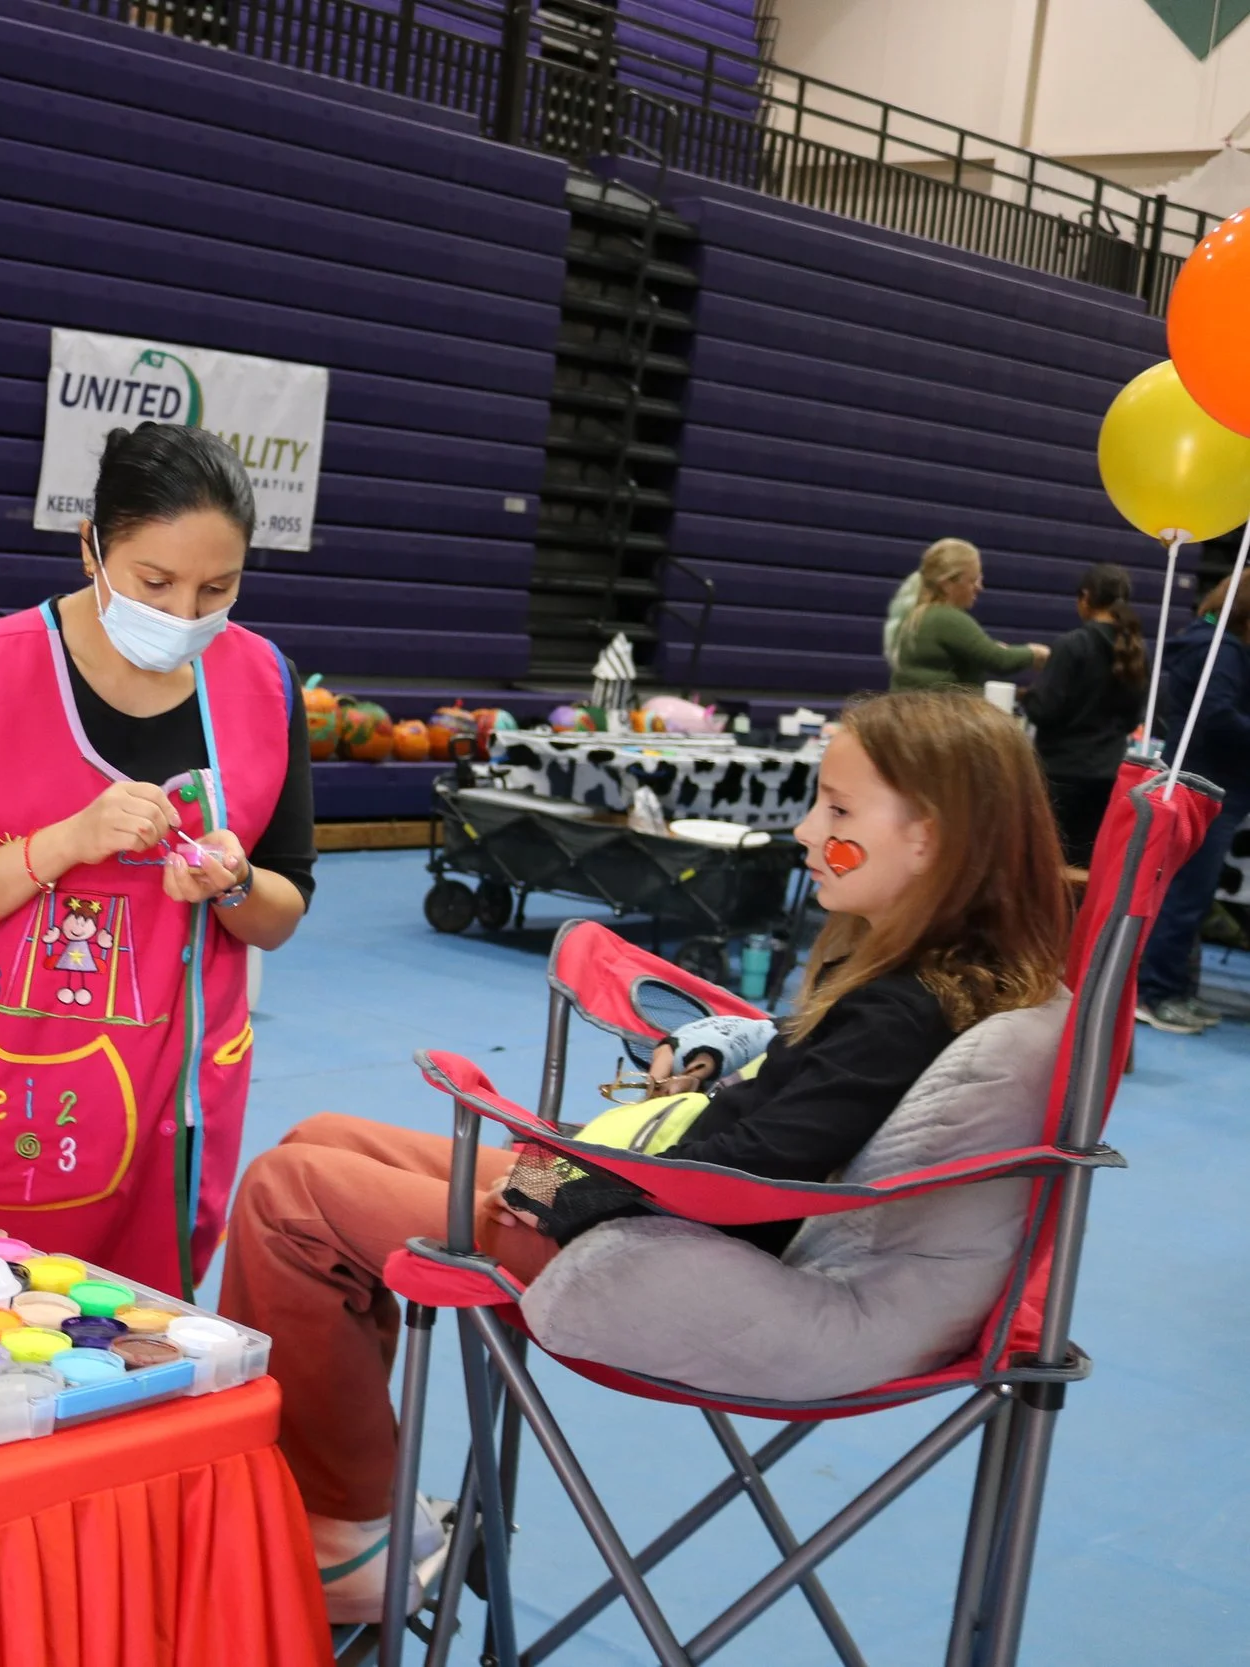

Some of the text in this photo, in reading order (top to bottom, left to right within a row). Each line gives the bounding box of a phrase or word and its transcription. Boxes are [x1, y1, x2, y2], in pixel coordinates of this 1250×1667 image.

[59, 372, 182, 420] UNITED
[217, 430, 309, 473] ALITY
[56, 1091, 77, 1126] 2
[58, 1137, 77, 1172] 3
